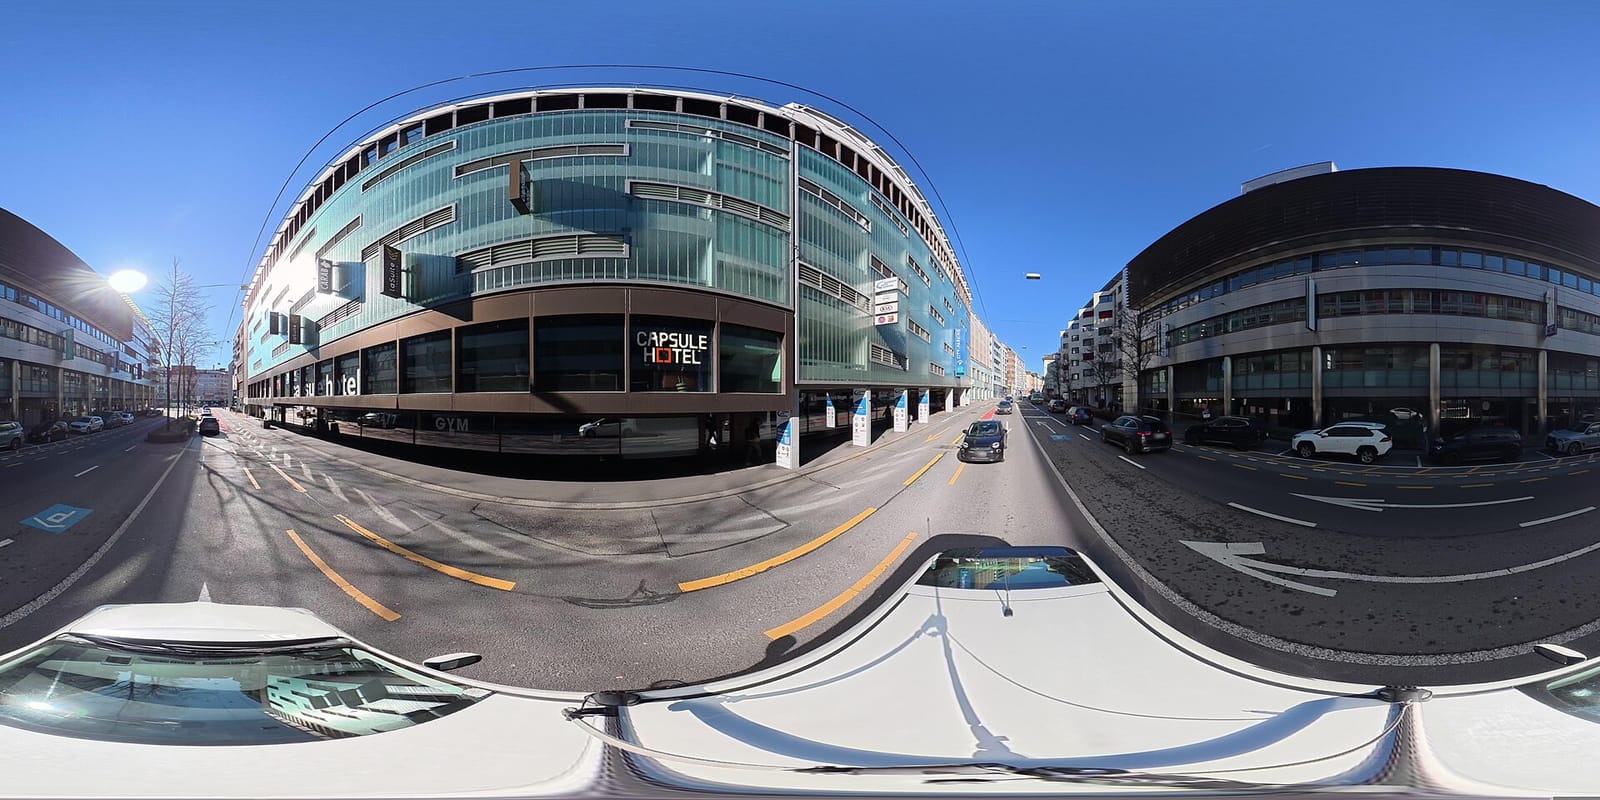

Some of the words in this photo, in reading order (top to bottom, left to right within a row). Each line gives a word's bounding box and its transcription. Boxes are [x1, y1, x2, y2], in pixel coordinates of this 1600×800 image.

[637, 331, 707, 349] CAPSULE
[644, 347, 701, 364] HOTEL
[435, 417, 469, 432] GYM
